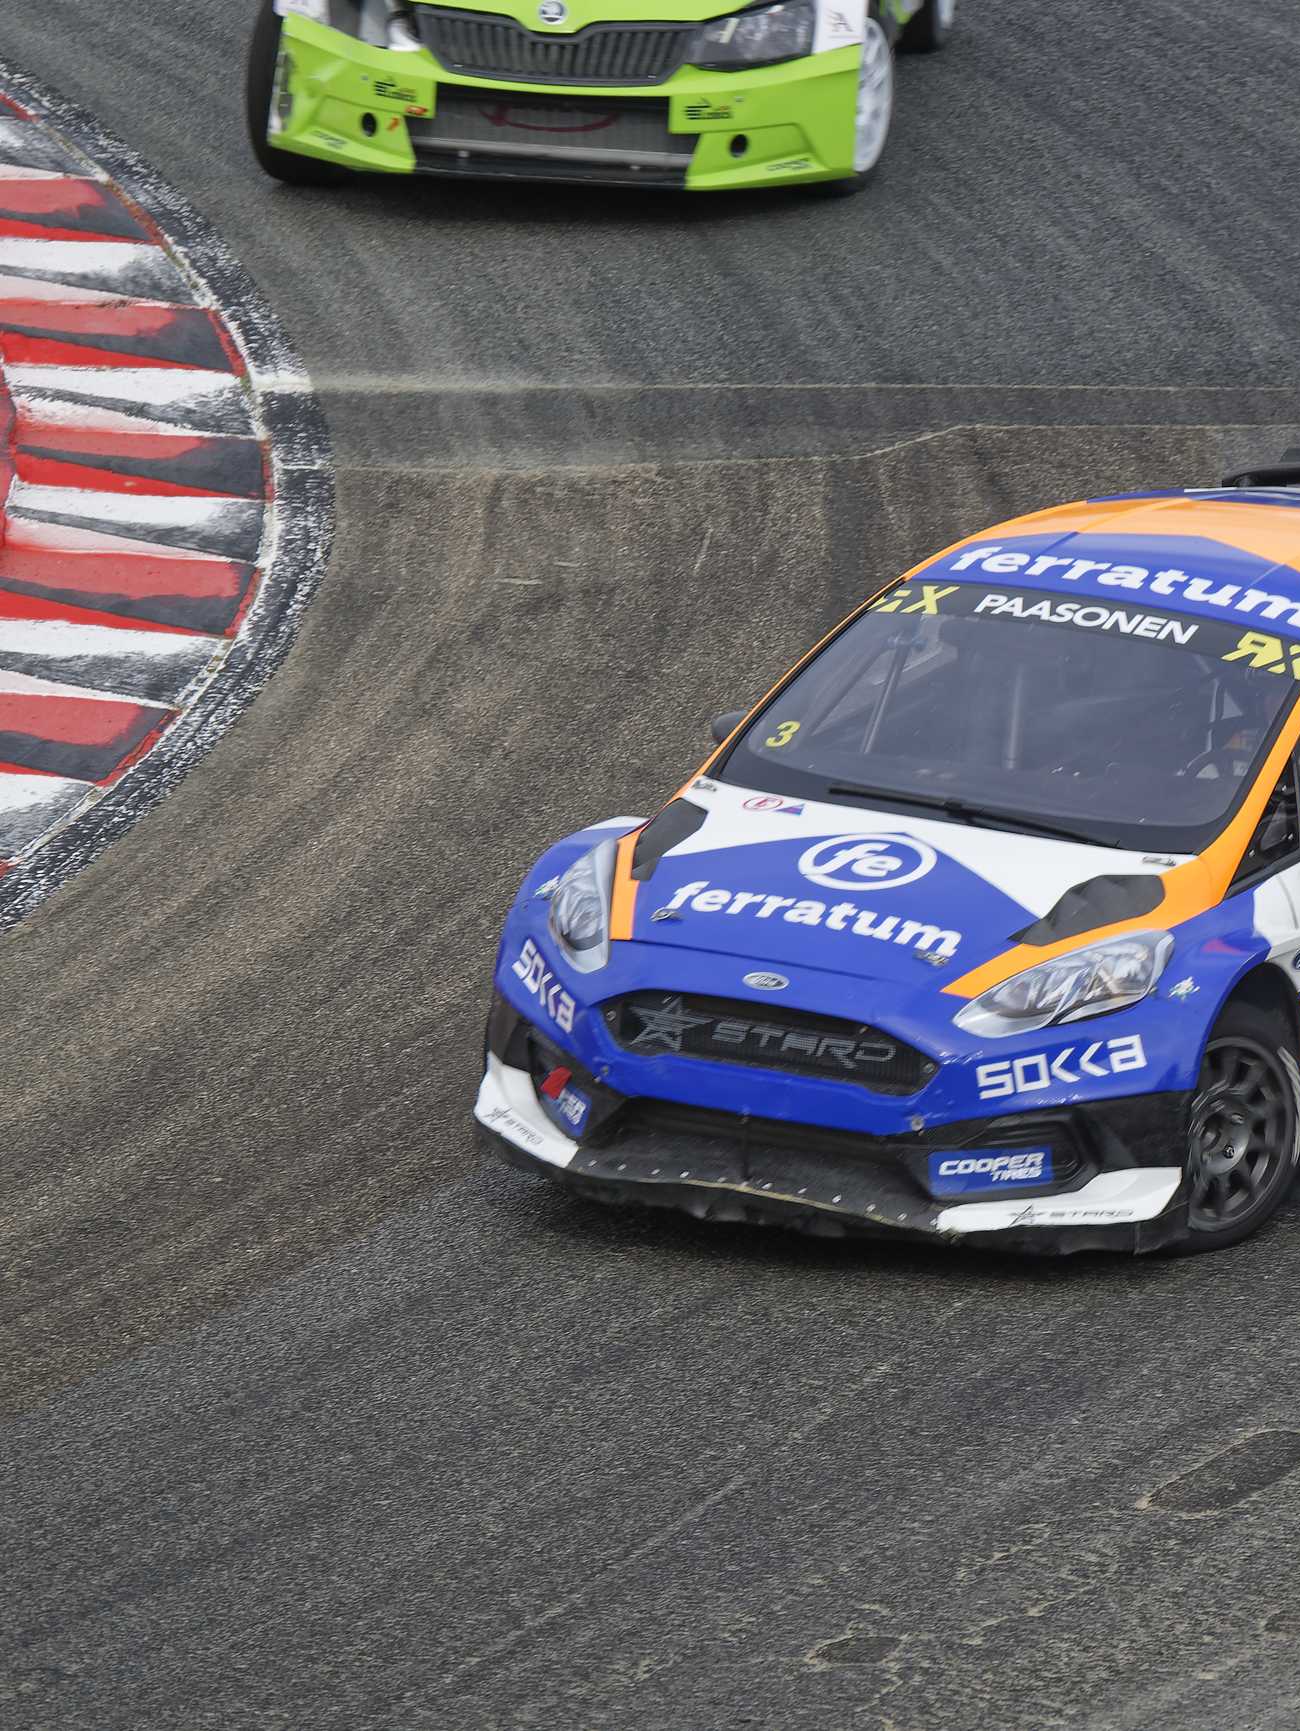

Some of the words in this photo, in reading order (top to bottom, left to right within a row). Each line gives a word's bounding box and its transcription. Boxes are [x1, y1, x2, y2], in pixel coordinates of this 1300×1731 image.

[973, 594, 1198, 644] PAASONEN
[765, 720, 800, 747] 3
[663, 881, 963, 957] ferratum
[712, 1022, 897, 1069] STARD
[938, 1152, 1045, 1176] COOPER
[991, 1165, 1042, 1182] TIRES
